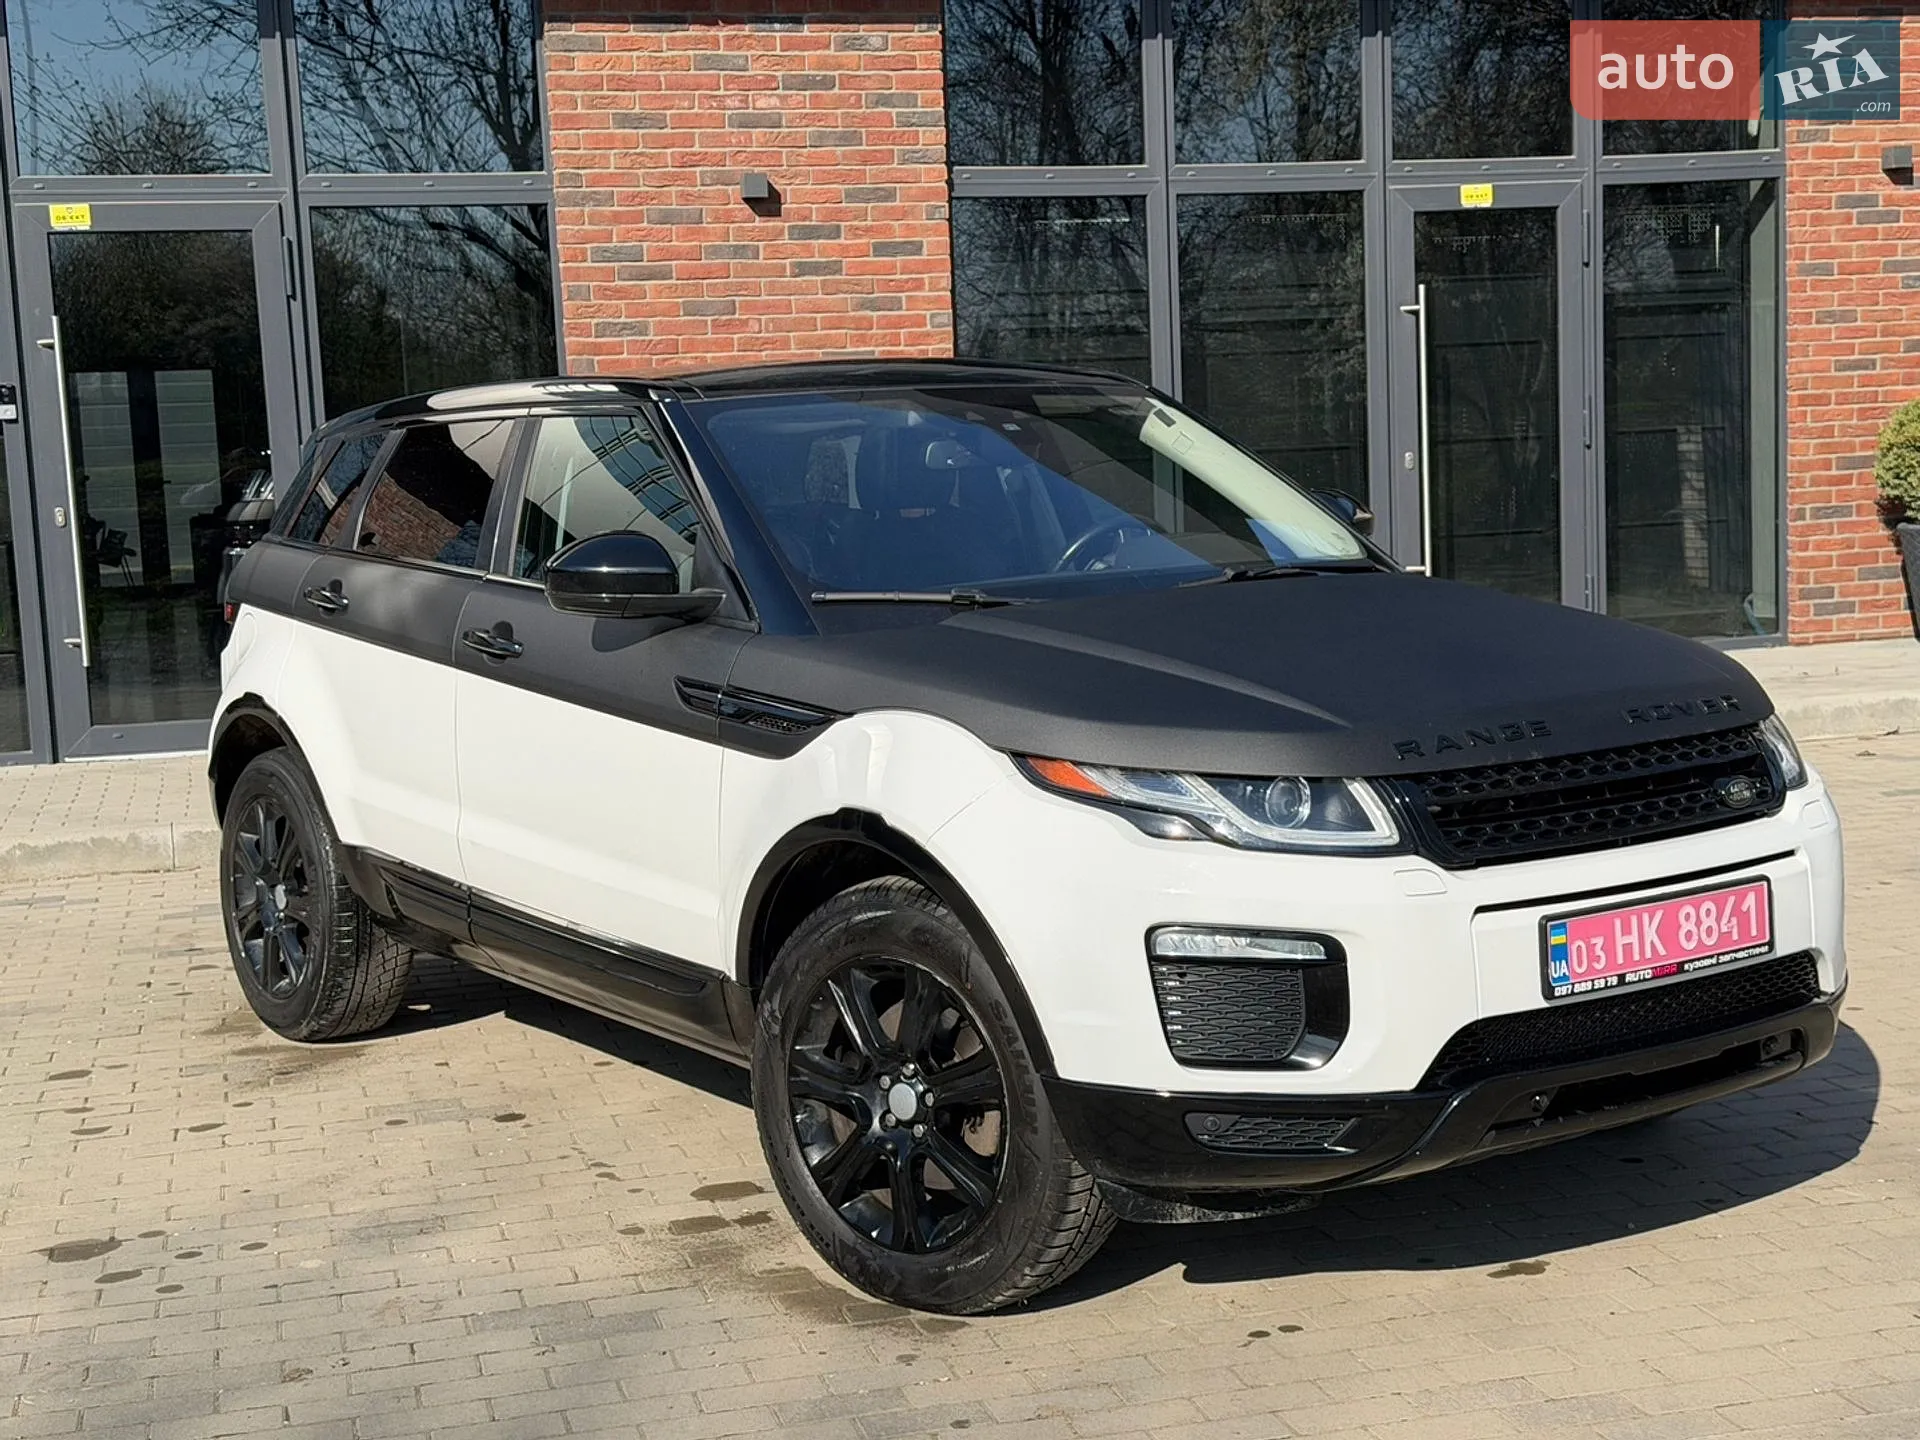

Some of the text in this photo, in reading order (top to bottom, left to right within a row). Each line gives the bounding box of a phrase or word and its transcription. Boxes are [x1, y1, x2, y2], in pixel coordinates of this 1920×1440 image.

[1391, 694, 1743, 761] RANGE ROVER
[1571, 891, 1757, 974] 03 HK 8841
[1550, 960, 1569, 978] UA
[1554, 984, 1573, 997] 097
[1607, 975, 1618, 987] 79
